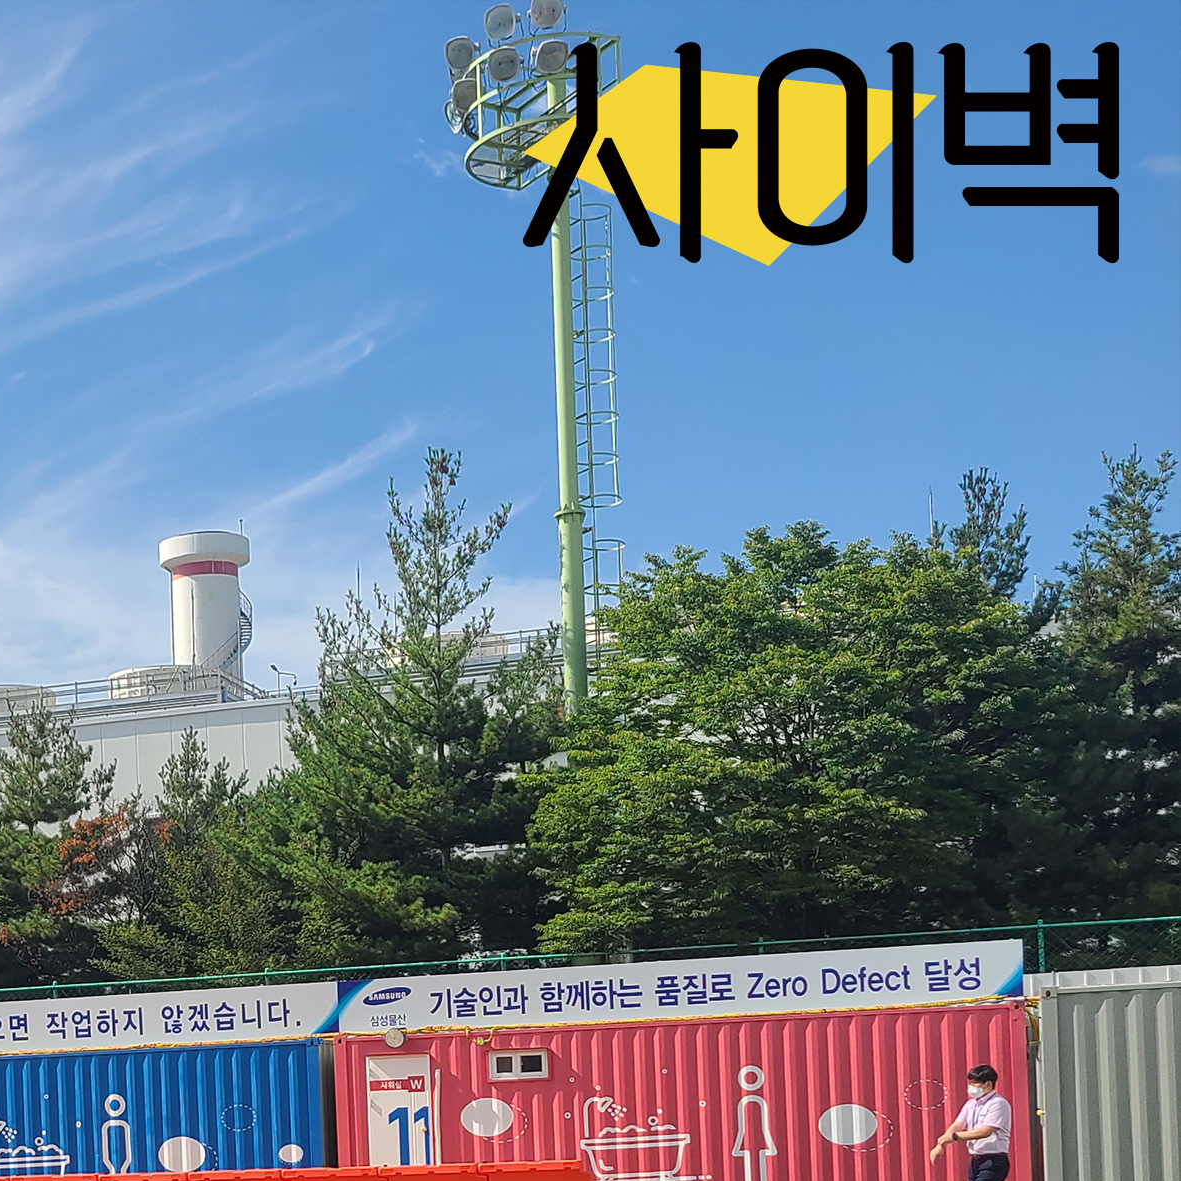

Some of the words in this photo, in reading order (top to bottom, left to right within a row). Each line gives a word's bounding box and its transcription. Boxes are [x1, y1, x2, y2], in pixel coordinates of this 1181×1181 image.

[367, 989, 410, 1003] SAMSUNG
[430, 984, 528, 1018] 기술인과
[539, 978, 642, 1012] 함께하는
[655, 973, 736, 1006] 품질로
[747, 971, 808, 999] Zero
[822, 964, 911, 995] Defect
[924, 957, 982, 992] 달성
[46, 1006, 144, 1039] 작업하지
[161, 998, 301, 1034] 않겠습니다.
[370, 1014, 407, 1026] 삼성물산
[410, 1079, 423, 1089] W
[388, 1106, 431, 1166] 11
